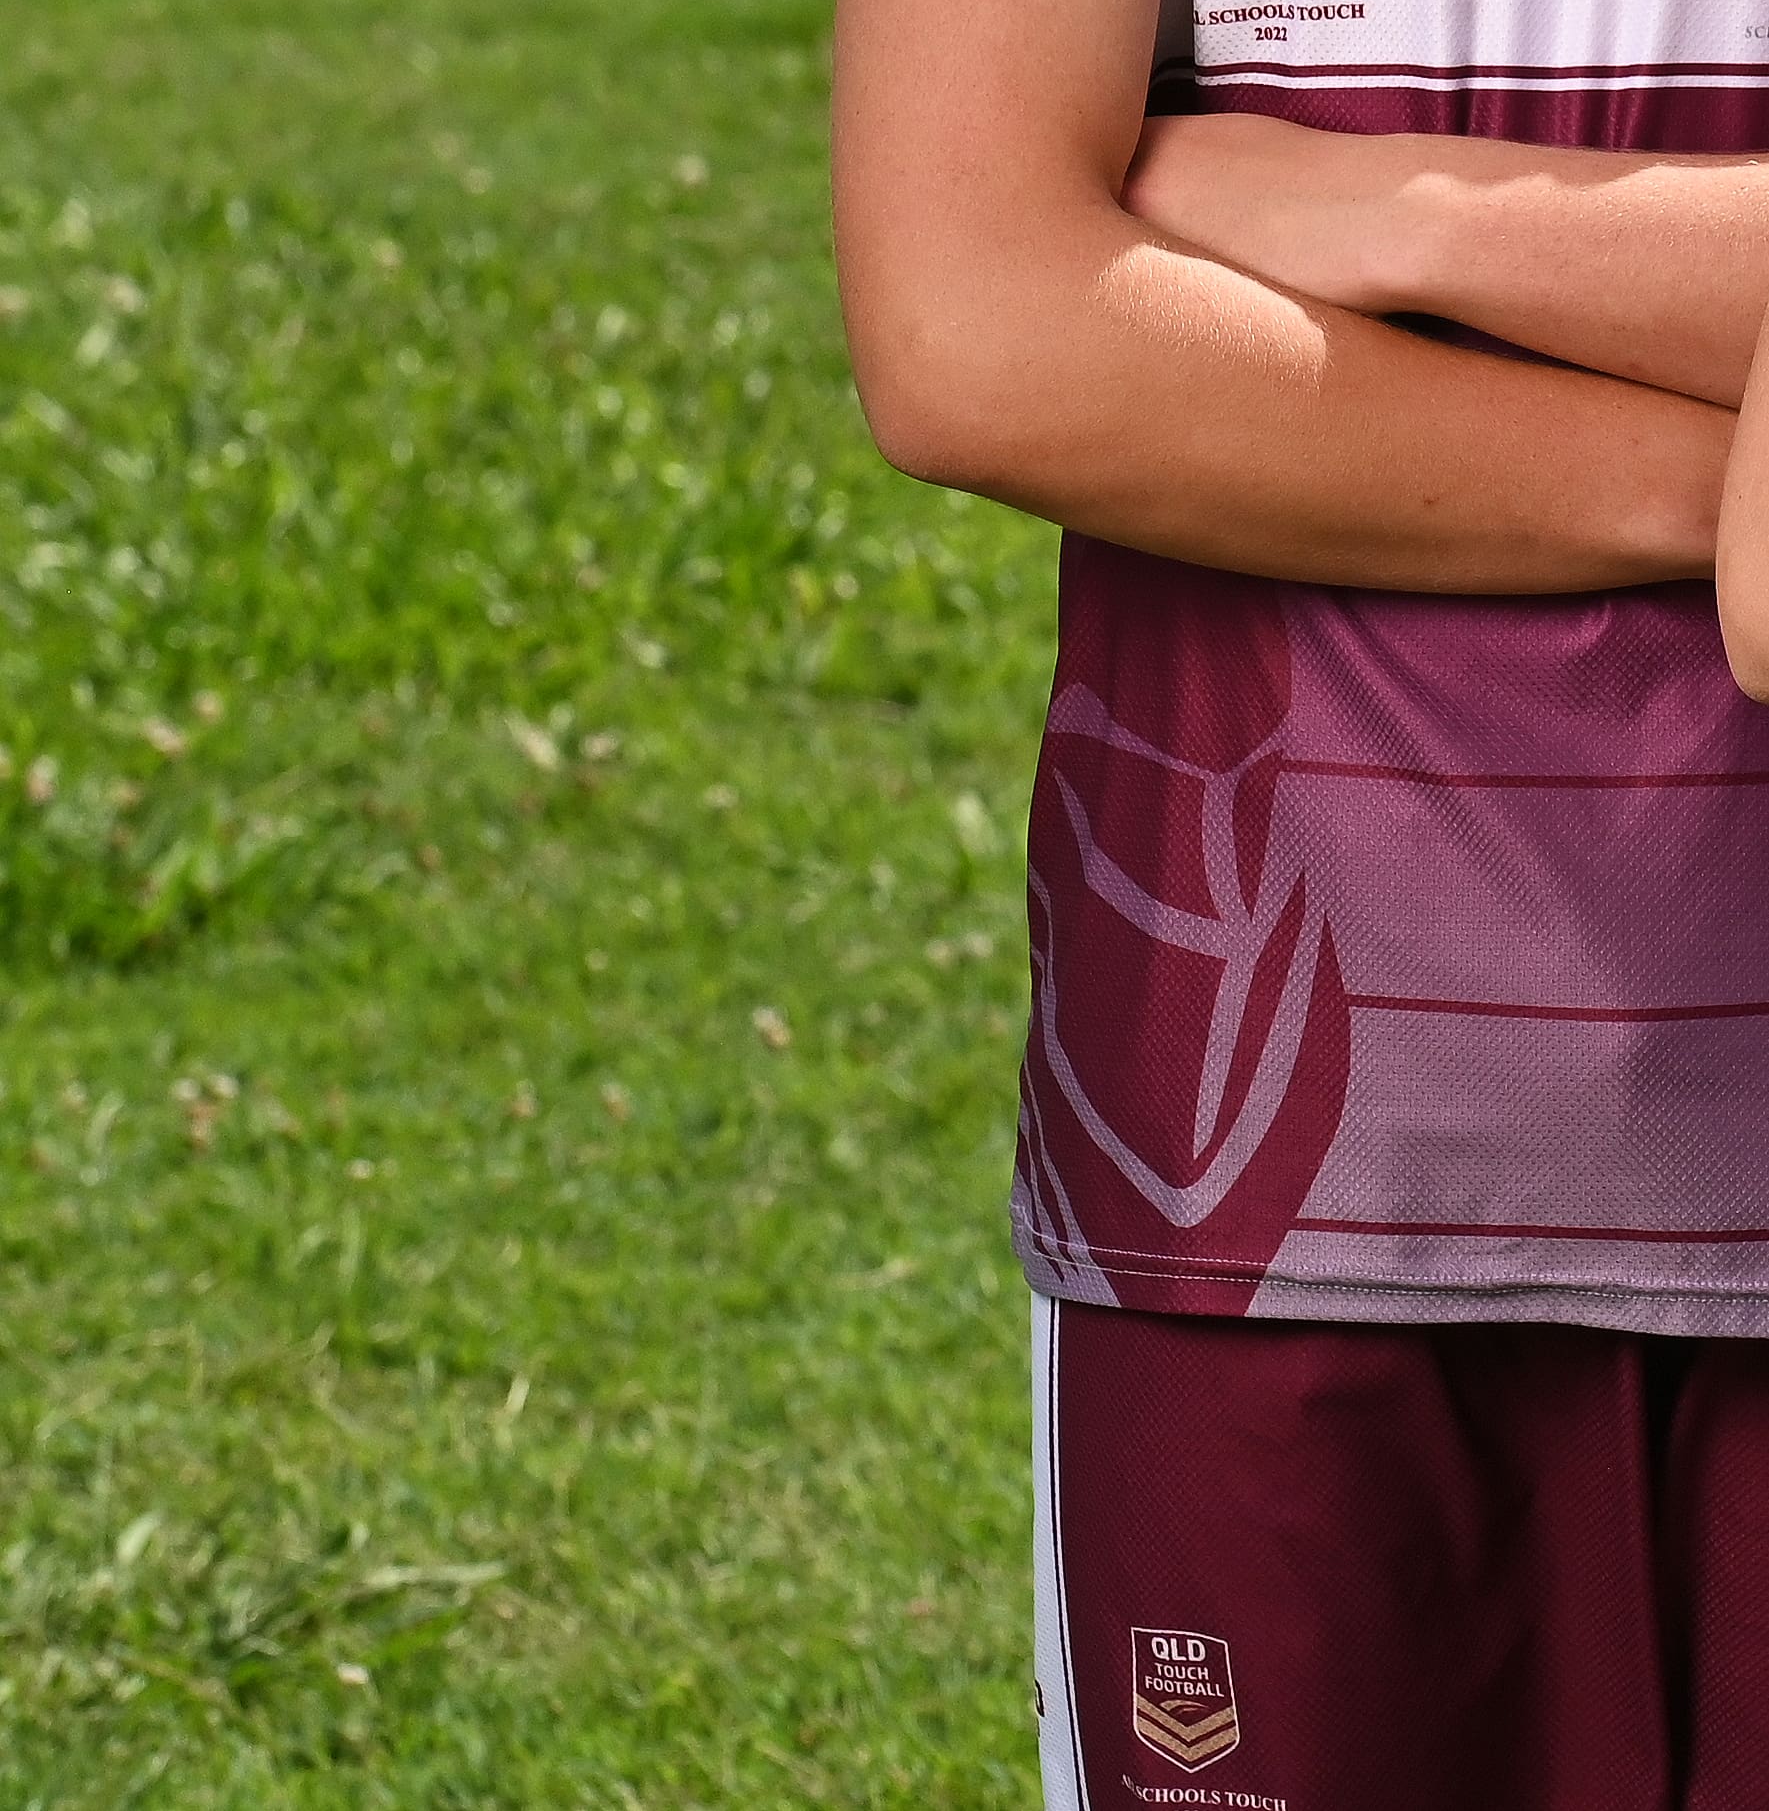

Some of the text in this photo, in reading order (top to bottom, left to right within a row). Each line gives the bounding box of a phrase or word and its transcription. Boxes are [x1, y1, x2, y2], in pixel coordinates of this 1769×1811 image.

[1207, 4, 1296, 26] SCHOOLS
[1297, 3, 1366, 21] TOUCH
[1254, 27, 1288, 42] 2022
[1151, 1636, 1207, 1662] QLD
[1154, 1662, 1209, 1681] TOUCH
[1144, 1675, 1225, 1698] FOOTBALL
[1224, 1791, 1288, 1811] TOUCH
